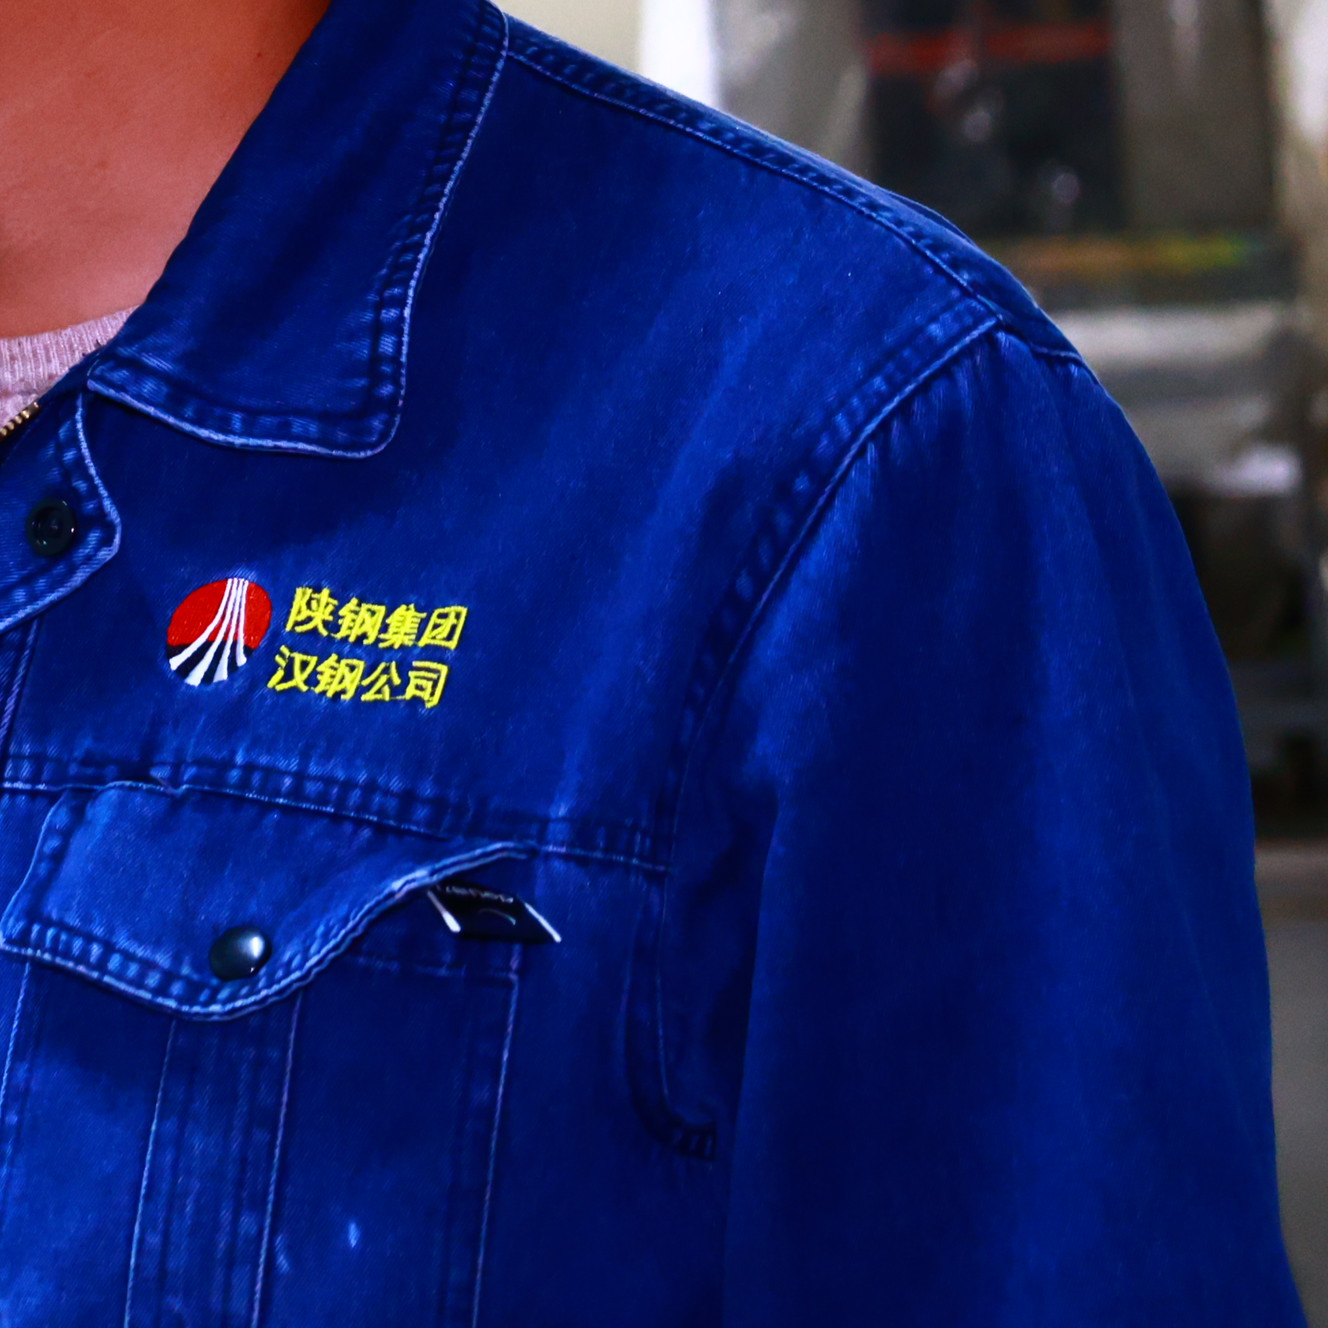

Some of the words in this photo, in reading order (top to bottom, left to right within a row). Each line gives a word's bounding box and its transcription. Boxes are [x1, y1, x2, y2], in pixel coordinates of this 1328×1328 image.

[285, 587, 468, 650] 陕钢集团
[267, 645, 449, 708] 汉钢公司
